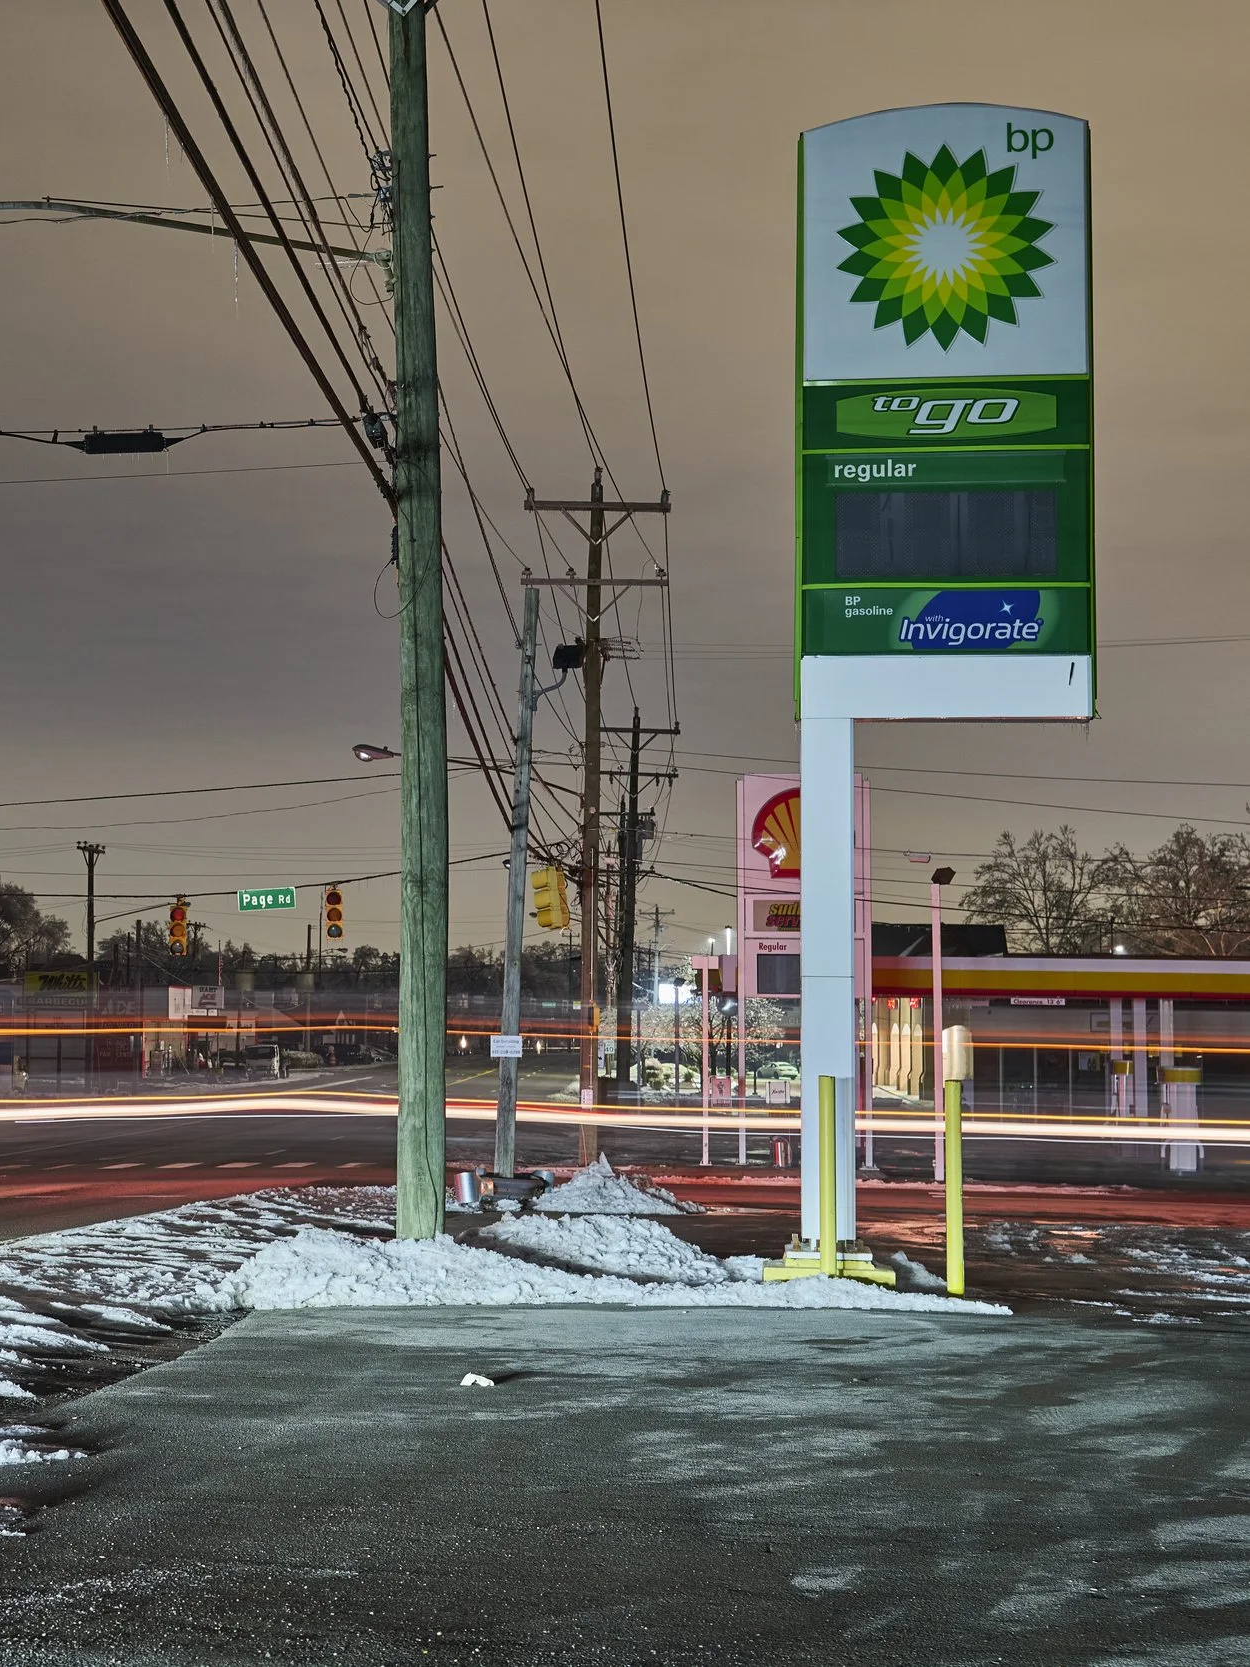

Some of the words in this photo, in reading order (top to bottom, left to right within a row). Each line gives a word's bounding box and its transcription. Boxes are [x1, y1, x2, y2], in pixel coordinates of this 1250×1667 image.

[1007, 122, 1054, 159] bp
[874, 397, 920, 411] to
[909, 398, 1019, 434] go
[834, 459, 917, 482] regular
[845, 596, 861, 606] BP
[845, 606, 893, 618] gasoline
[900, 618, 1039, 646] Invigorate
[243, 893, 273, 908] Page
[278, 894, 291, 904] Rd
[758, 942, 787, 952] Regular
